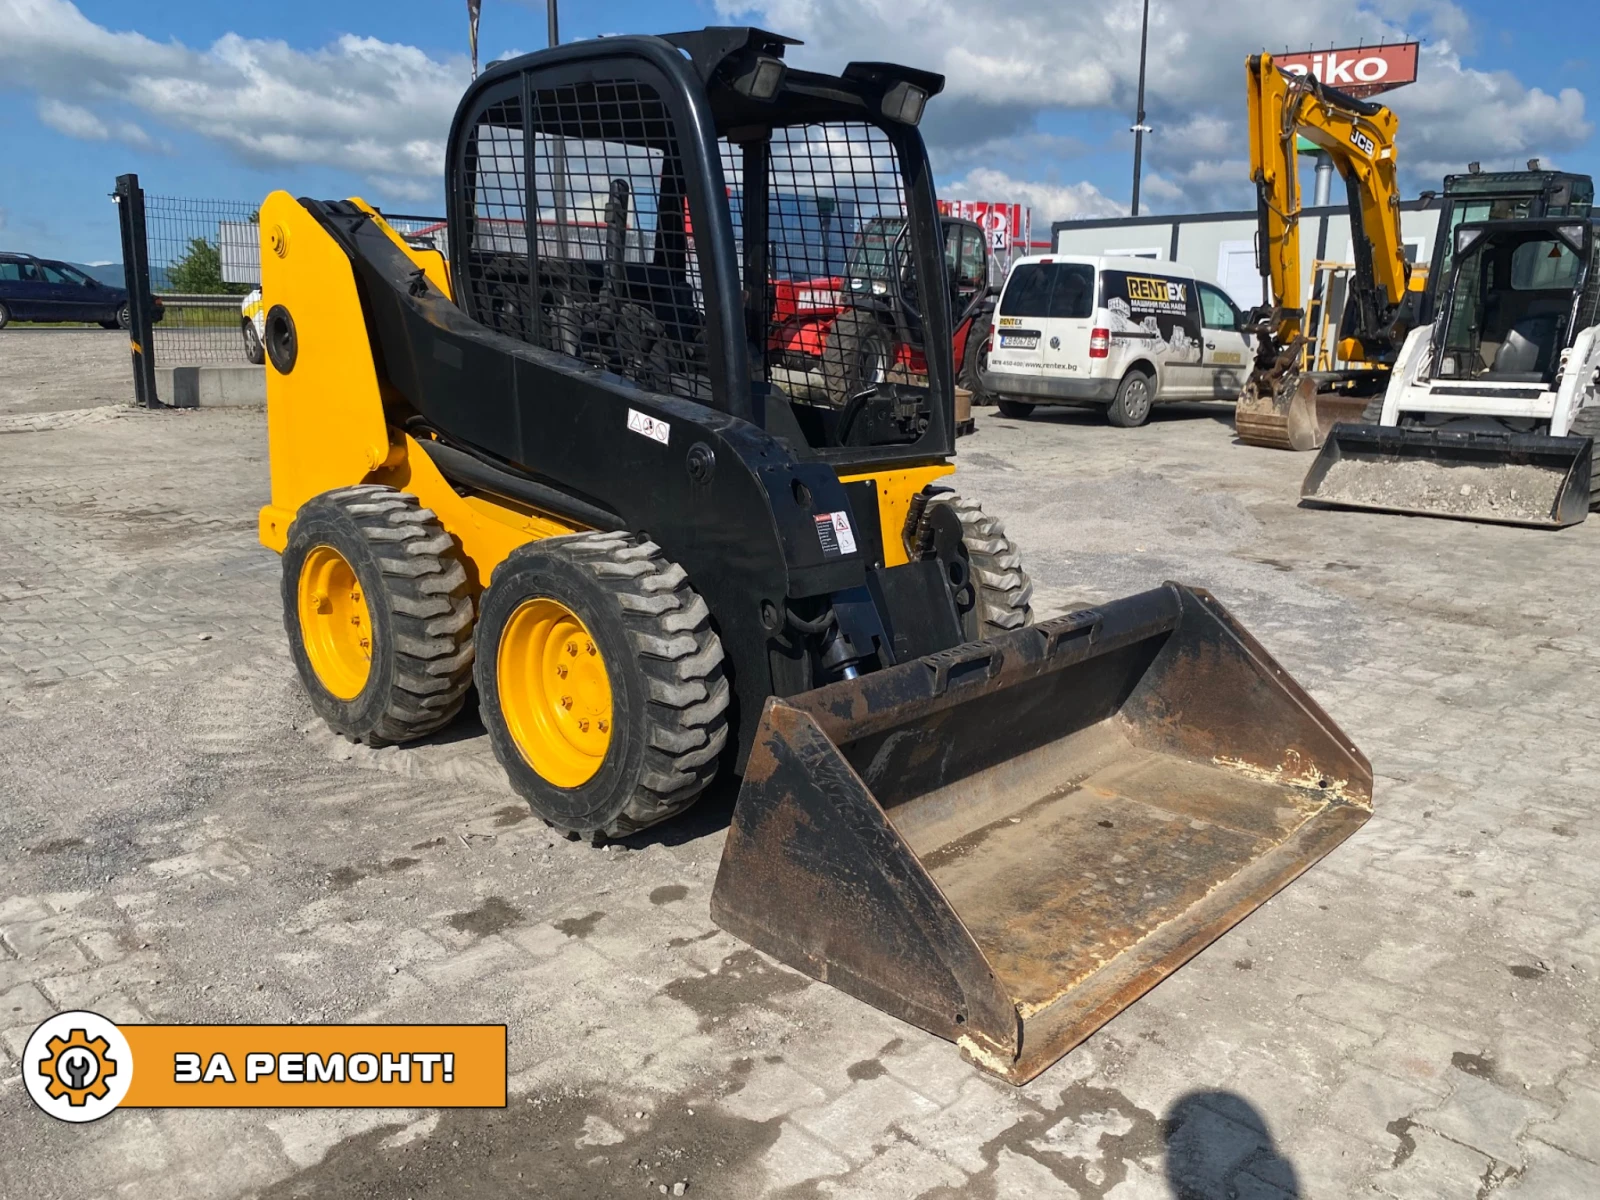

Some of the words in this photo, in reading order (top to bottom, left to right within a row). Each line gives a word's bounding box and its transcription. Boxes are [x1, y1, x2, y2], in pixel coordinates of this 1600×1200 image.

[1350, 131, 1374, 156] JCB
[1129, 278, 1185, 301] RENTEX
[999, 318, 1022, 326] RENTEX
